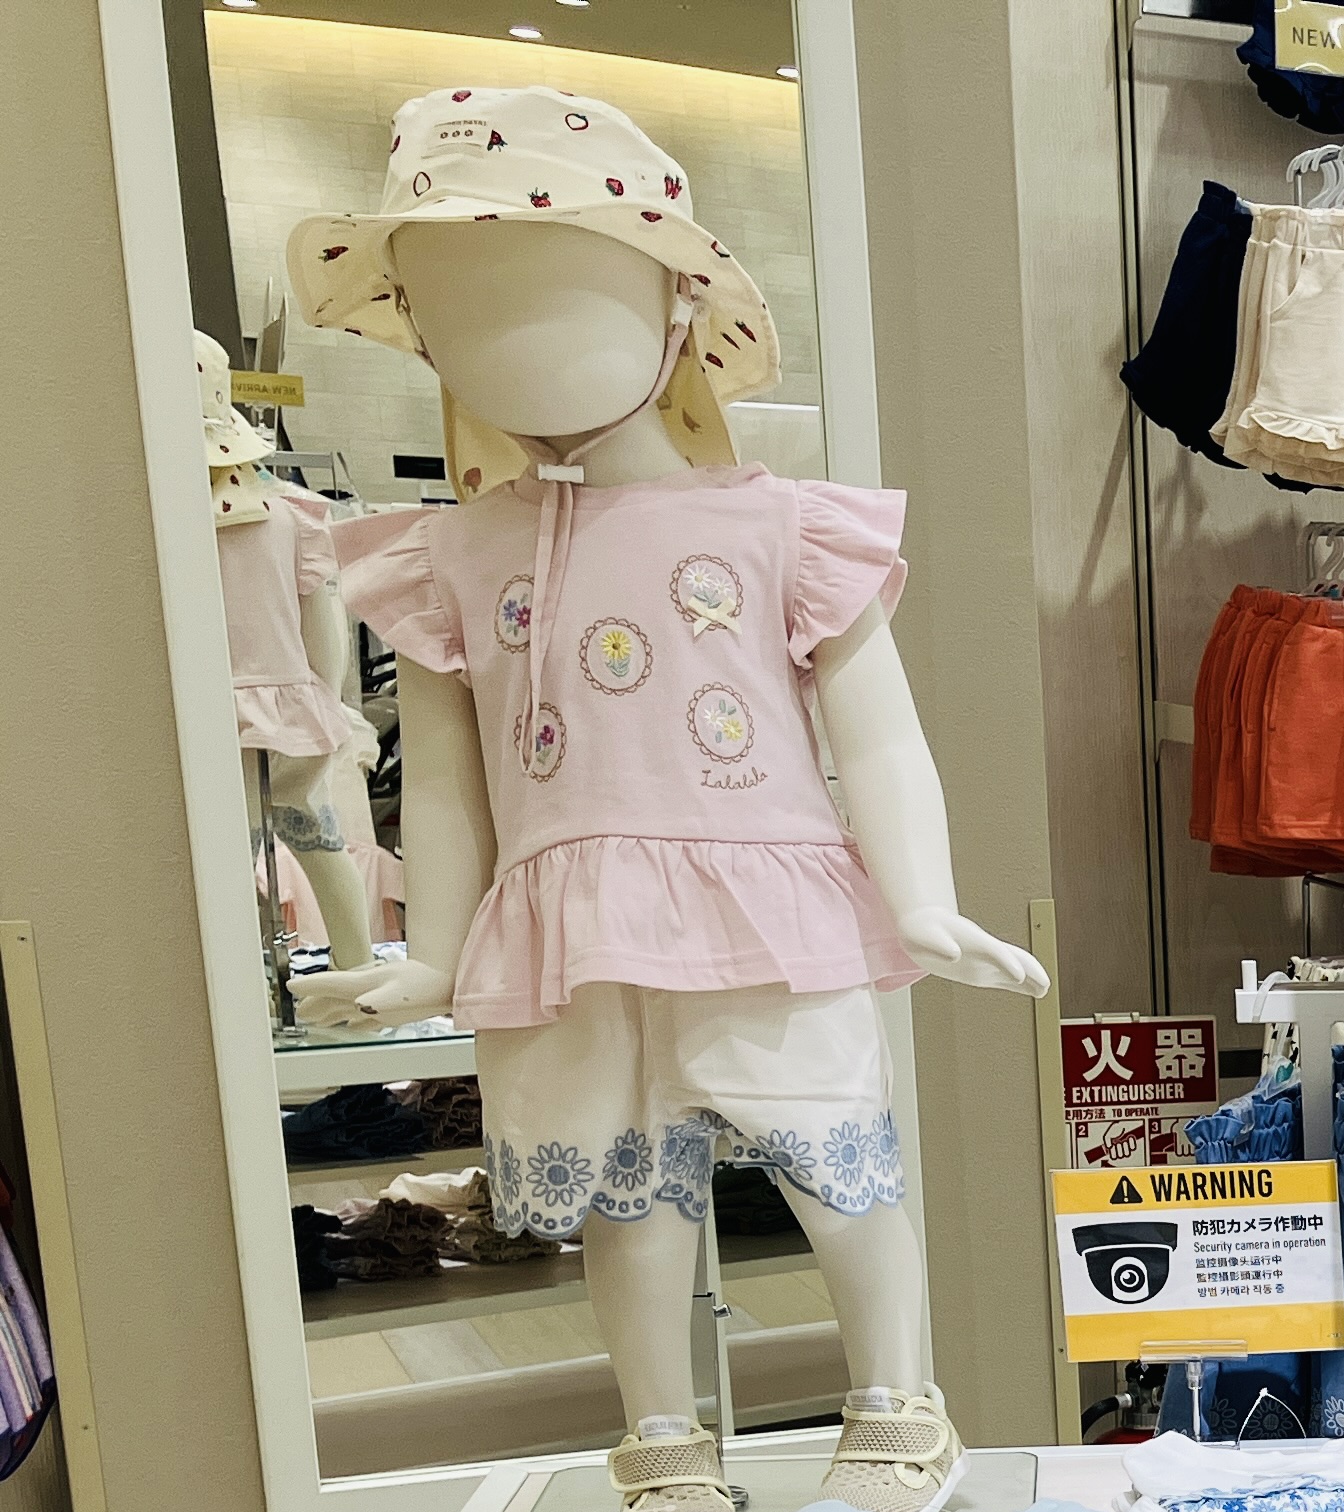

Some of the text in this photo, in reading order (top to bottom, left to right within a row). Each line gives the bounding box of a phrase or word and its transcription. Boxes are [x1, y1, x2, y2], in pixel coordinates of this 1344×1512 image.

[1292, 26, 1336, 50] NEW
[1072, 1083, 1185, 1104] EXTINGUISHER
[1112, 1108, 1122, 1118] TO
[1124, 1106, 1159, 1117] OPERATE
[1077, 1125, 1086, 1136] 2
[1151, 1121, 1159, 1132] 3
[1150, 1169, 1273, 1201] WARNING
[1192, 1214, 1324, 1236] 防犯カメラ作動中
[1193, 1236, 1326, 1254] Security camera in operation
